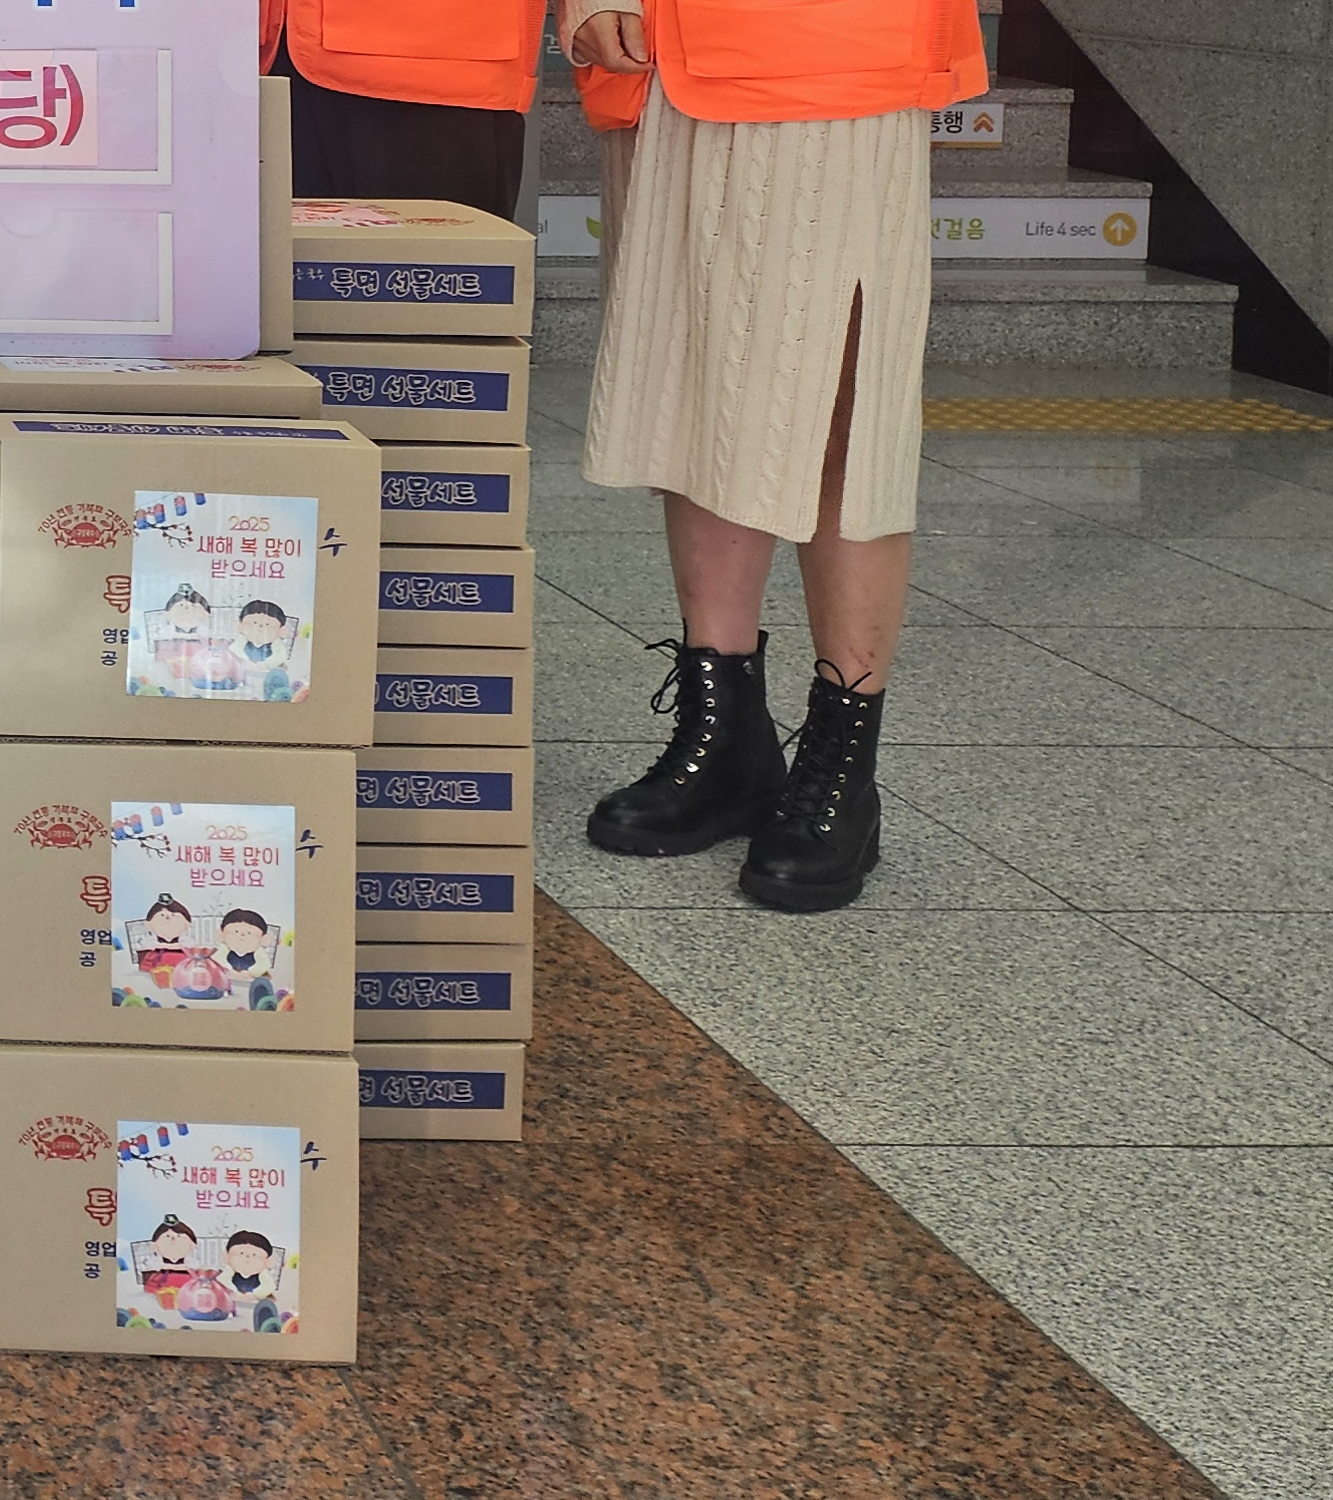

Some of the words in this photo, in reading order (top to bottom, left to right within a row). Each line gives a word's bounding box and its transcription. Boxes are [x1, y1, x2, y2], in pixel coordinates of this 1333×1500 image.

[1026, 221, 1054, 237] Life
[1057, 222, 1066, 236] 4
[1070, 224, 1096, 237] sec
[330, 268, 379, 298] 특면
[386, 269, 482, 300] 선물세트
[326, 372, 375, 402] 특면
[381, 373, 476, 405] 선물세트
[382, 476, 478, 507] 선물세트
[385, 577, 481, 608] 선물세트
[386, 679, 481, 710] 선물세트
[356, 777, 379, 803] 면
[385, 775, 481, 806] 선물세트
[357, 879, 381, 906] 면
[388, 878, 482, 908] 선물세트
[357, 978, 381, 1005] 면
[388, 977, 481, 1007] 선물세트
[381, 1075, 474, 1106] 선물세트
[212, 1145, 254, 1161] 2025
[181, 1165, 217, 1185] 새해
[225, 1166, 242, 1186] 복
[249, 1167, 286, 1188] 많이
[196, 1189, 271, 1210] 받으세요
